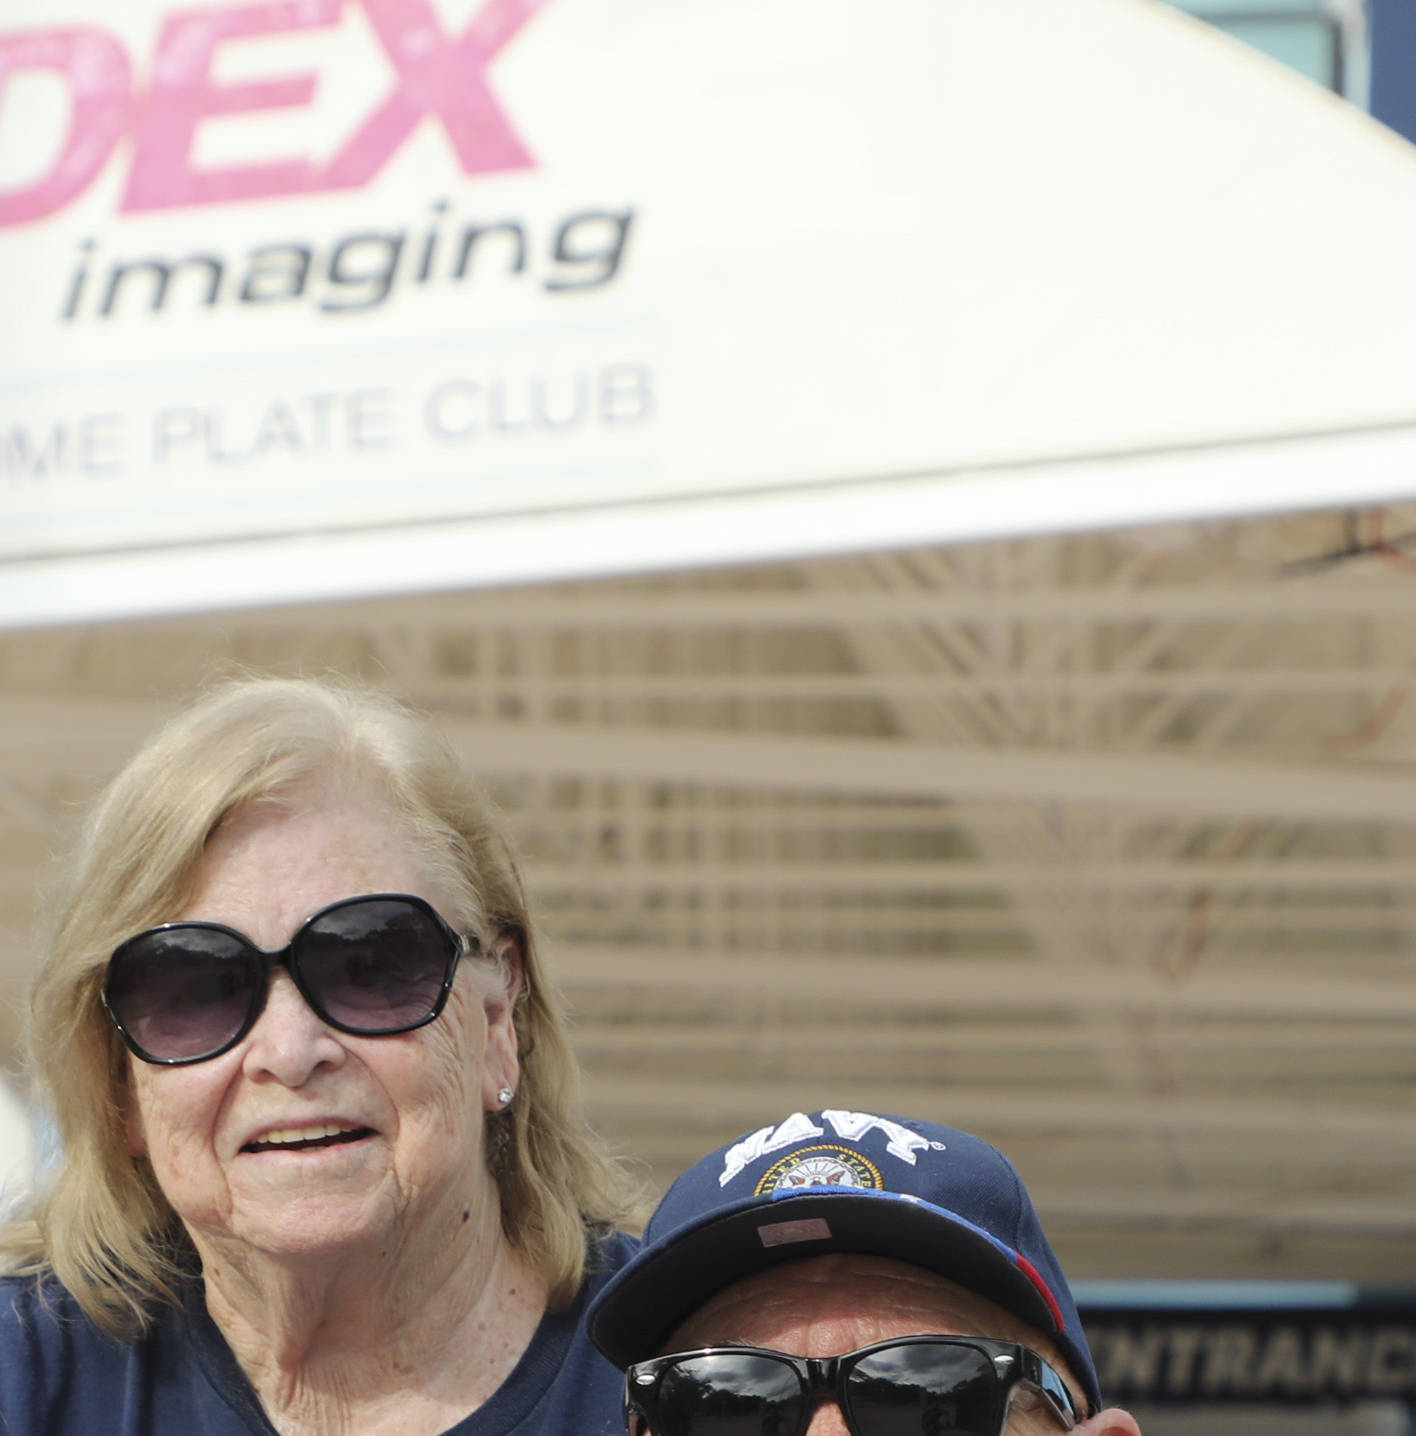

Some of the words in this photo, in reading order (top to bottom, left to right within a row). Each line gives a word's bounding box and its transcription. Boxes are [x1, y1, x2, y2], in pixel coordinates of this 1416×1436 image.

[58, 199, 639, 323] imaging
[149, 387, 400, 470] PLATE
[421, 360, 658, 446] CLUB
